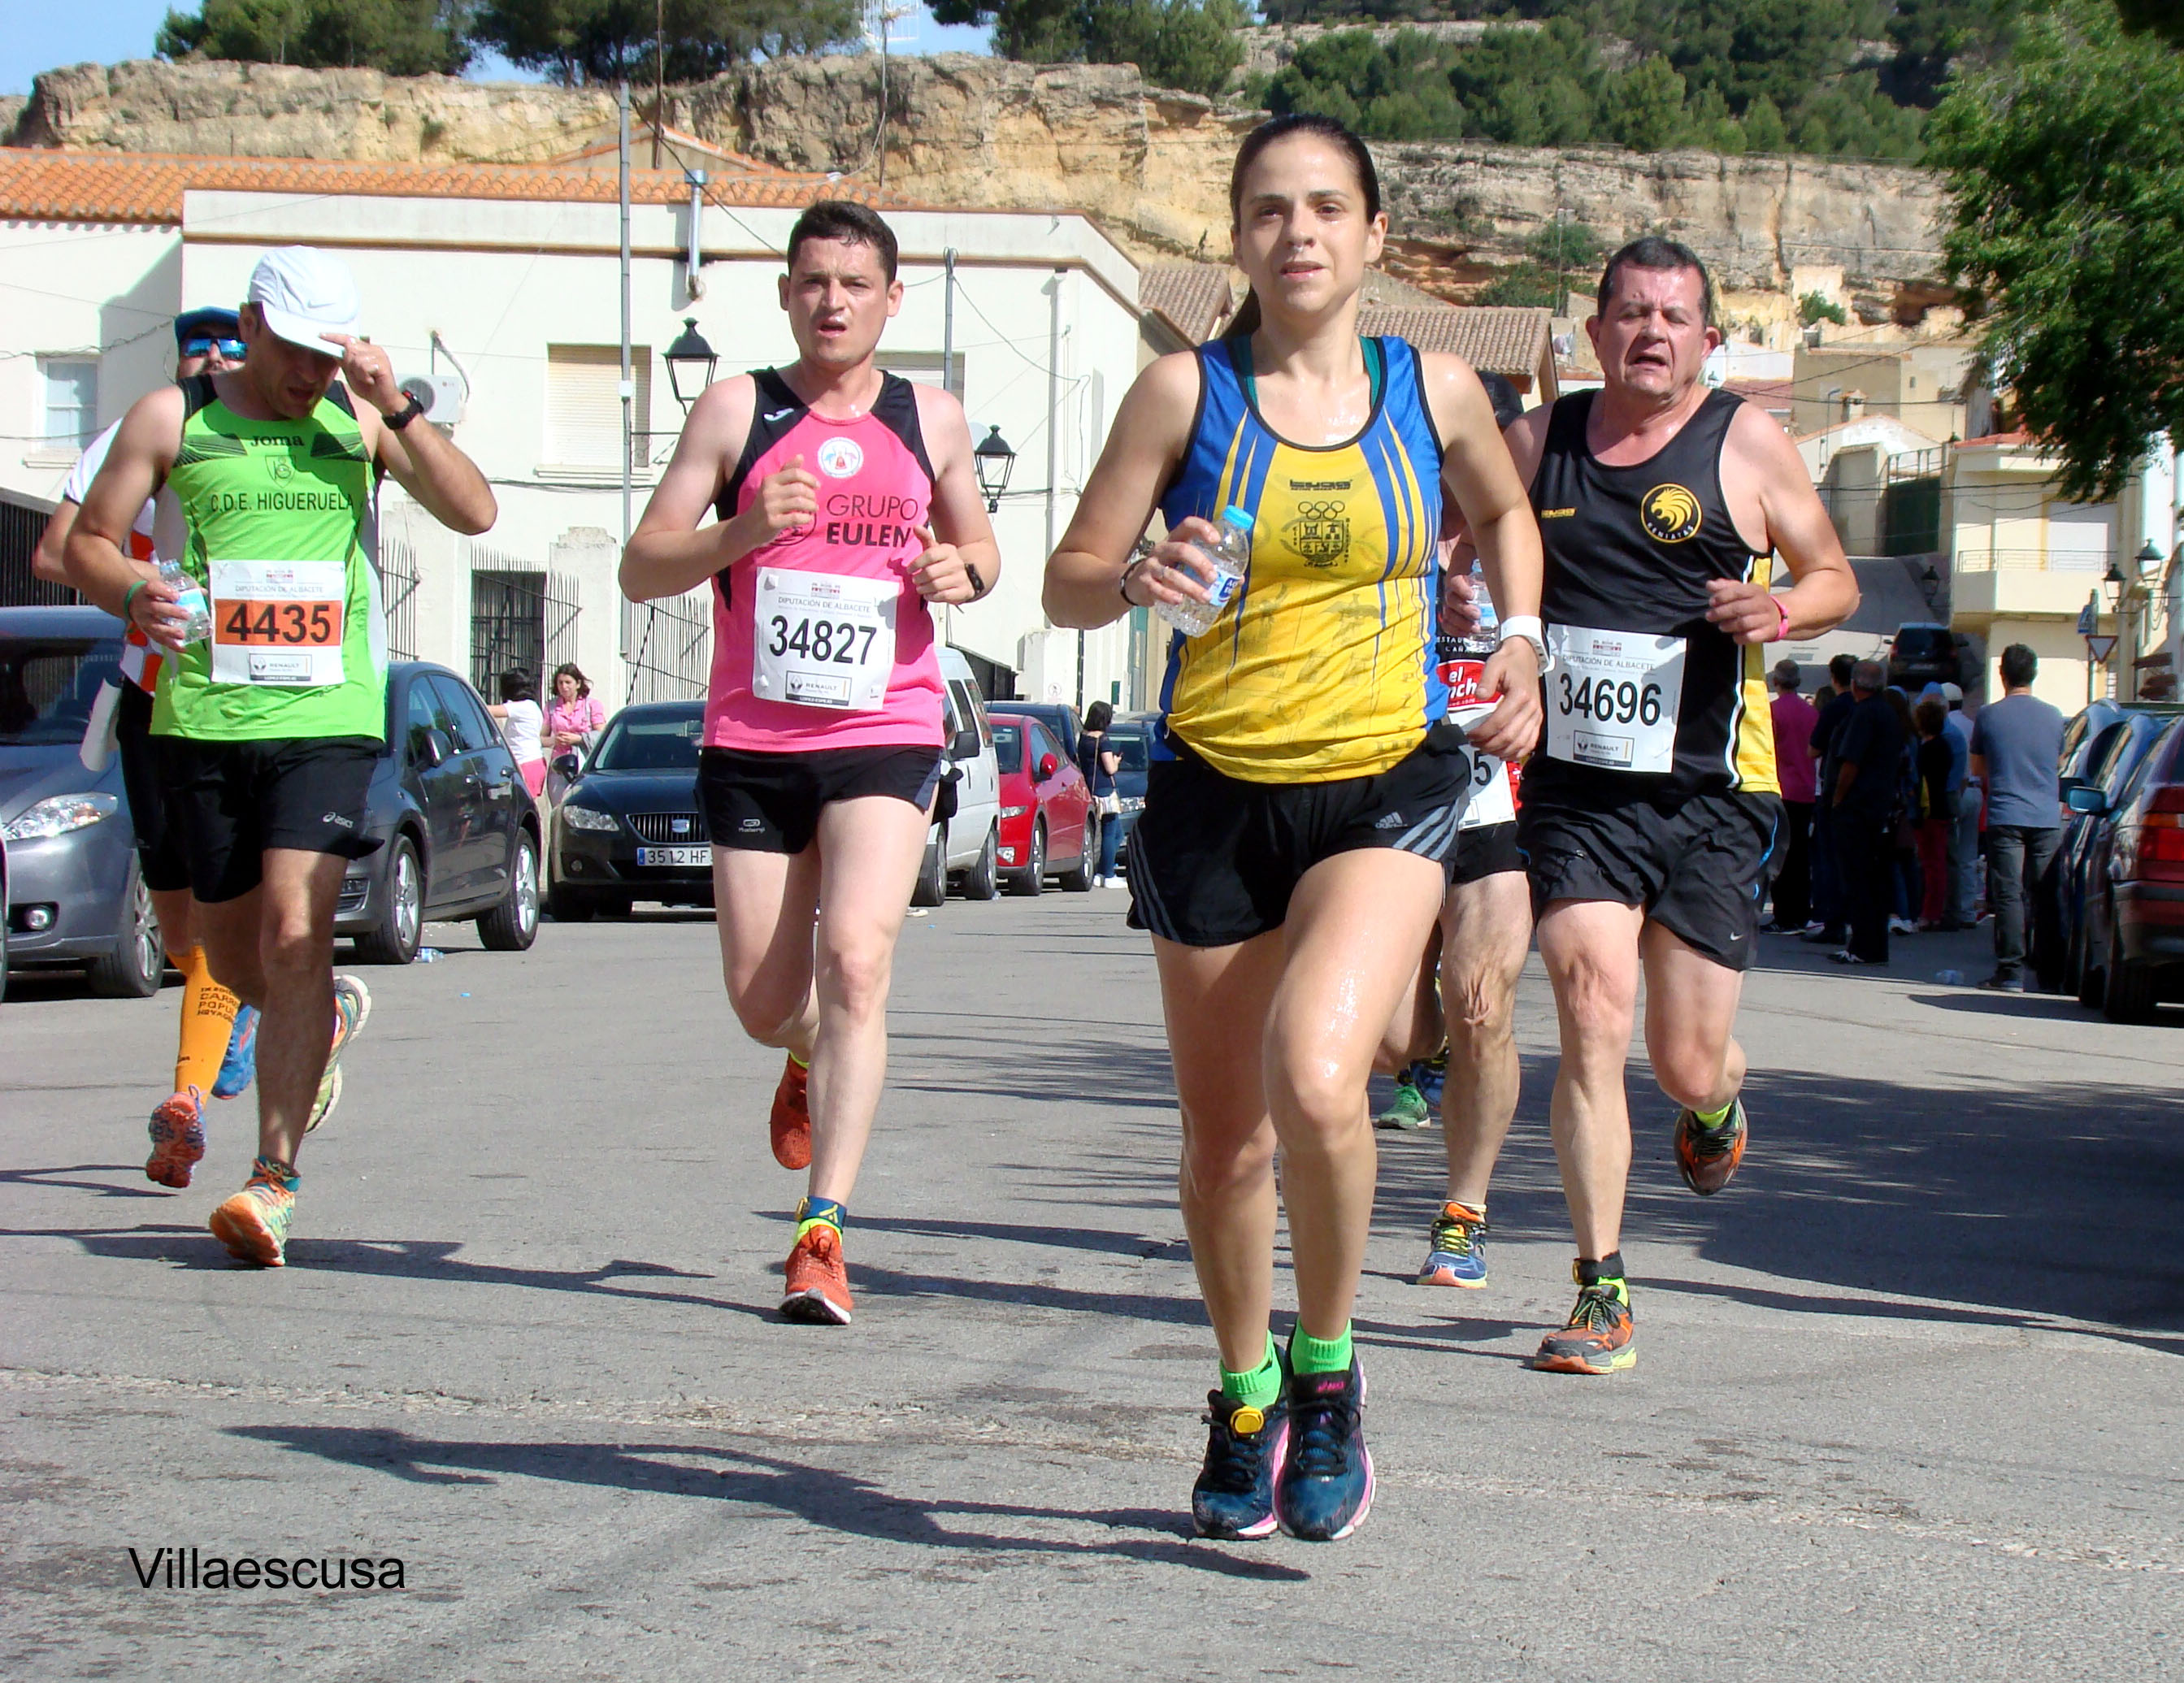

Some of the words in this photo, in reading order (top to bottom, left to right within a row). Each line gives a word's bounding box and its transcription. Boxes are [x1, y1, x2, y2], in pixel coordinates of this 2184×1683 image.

[211, 493, 252, 513] C.D.E.
[257, 492, 354, 511] HIGUERUELA
[826, 493, 918, 521] GRUPO
[826, 523, 911, 549] EULEN
[235, 584, 276, 593] DIPUTACIÓN
[278, 585, 288, 593] DE
[778, 596, 820, 608] DIPUTACIÓN
[834, 602, 871, 614] ALBACETE
[226, 602, 331, 643] 4435
[769, 615, 877, 666] 34827
[1562, 654, 1604, 666] DIPUTACIÓN
[1604, 659, 1613, 667] DE
[1616, 660, 1656, 671] ALBACETE
[1449, 666, 1464, 683] el
[805, 682, 837, 691] RENAULT
[1559, 673, 1662, 726] 34696
[1590, 743, 1619, 752] RENAULT
[648, 850, 685, 864] 3512
[690, 850, 714, 864] HF
